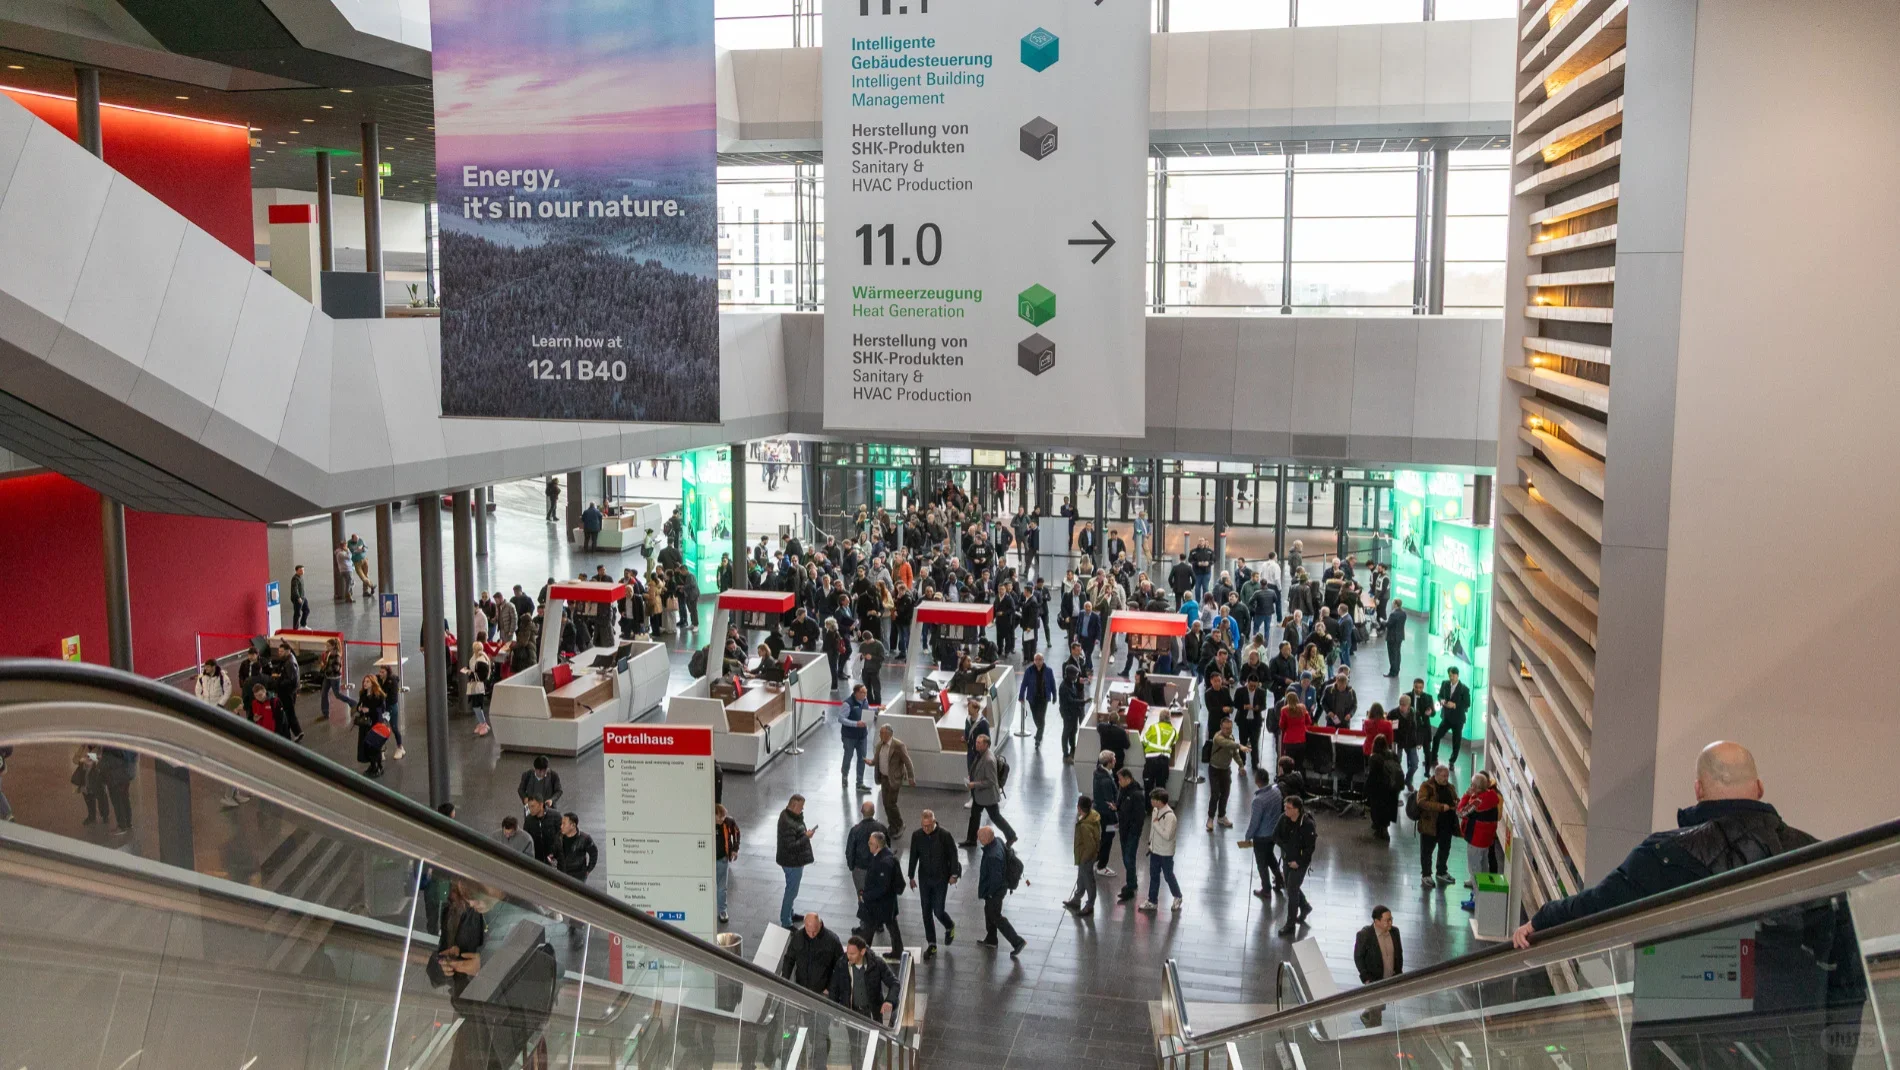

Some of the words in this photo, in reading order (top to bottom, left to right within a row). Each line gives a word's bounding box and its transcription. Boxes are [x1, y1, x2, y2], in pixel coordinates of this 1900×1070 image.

[852, 36, 936, 52] Intelligente
[851, 54, 993, 69] Gebäudesteuerung
[852, 74, 922, 90] Intelligent
[926, 71, 985, 88] Building
[852, 92, 945, 108] Management
[852, 122, 937, 138] Herstellung
[942, 124, 969, 135] von
[851, 140, 965, 155] SHK-Produkten
[852, 160, 909, 176] Sanitary
[913, 159, 924, 173] &
[463, 165, 560, 192] Energy,
[852, 178, 892, 192] HVAC
[897, 177, 973, 191] Production
[509, 196, 532, 218] in
[538, 200, 584, 218] our
[588, 195, 685, 217] nature.
[856, 222, 942, 266] 11.0
[852, 285, 983, 303] Wärmeerzeugung
[852, 304, 885, 317] Heat
[888, 304, 965, 318] Generation
[531, 335, 572, 347] Learn
[575, 335, 604, 348] how
[607, 337, 623, 348] at
[853, 333, 936, 350] Herstellung
[941, 337, 968, 347] von
[852, 351, 964, 366] SHK-Produkten
[527, 359, 571, 380] 12.1
[578, 360, 627, 381] B40
[853, 369, 909, 385] Sanitary
[913, 370, 924, 383] &
[853, 387, 892, 400] HVAC
[897, 388, 972, 402] Production
[606, 732, 674, 745] Portalhaus
[608, 759, 615, 769] C
[612, 837, 616, 846] 1
[609, 881, 621, 889] Via
